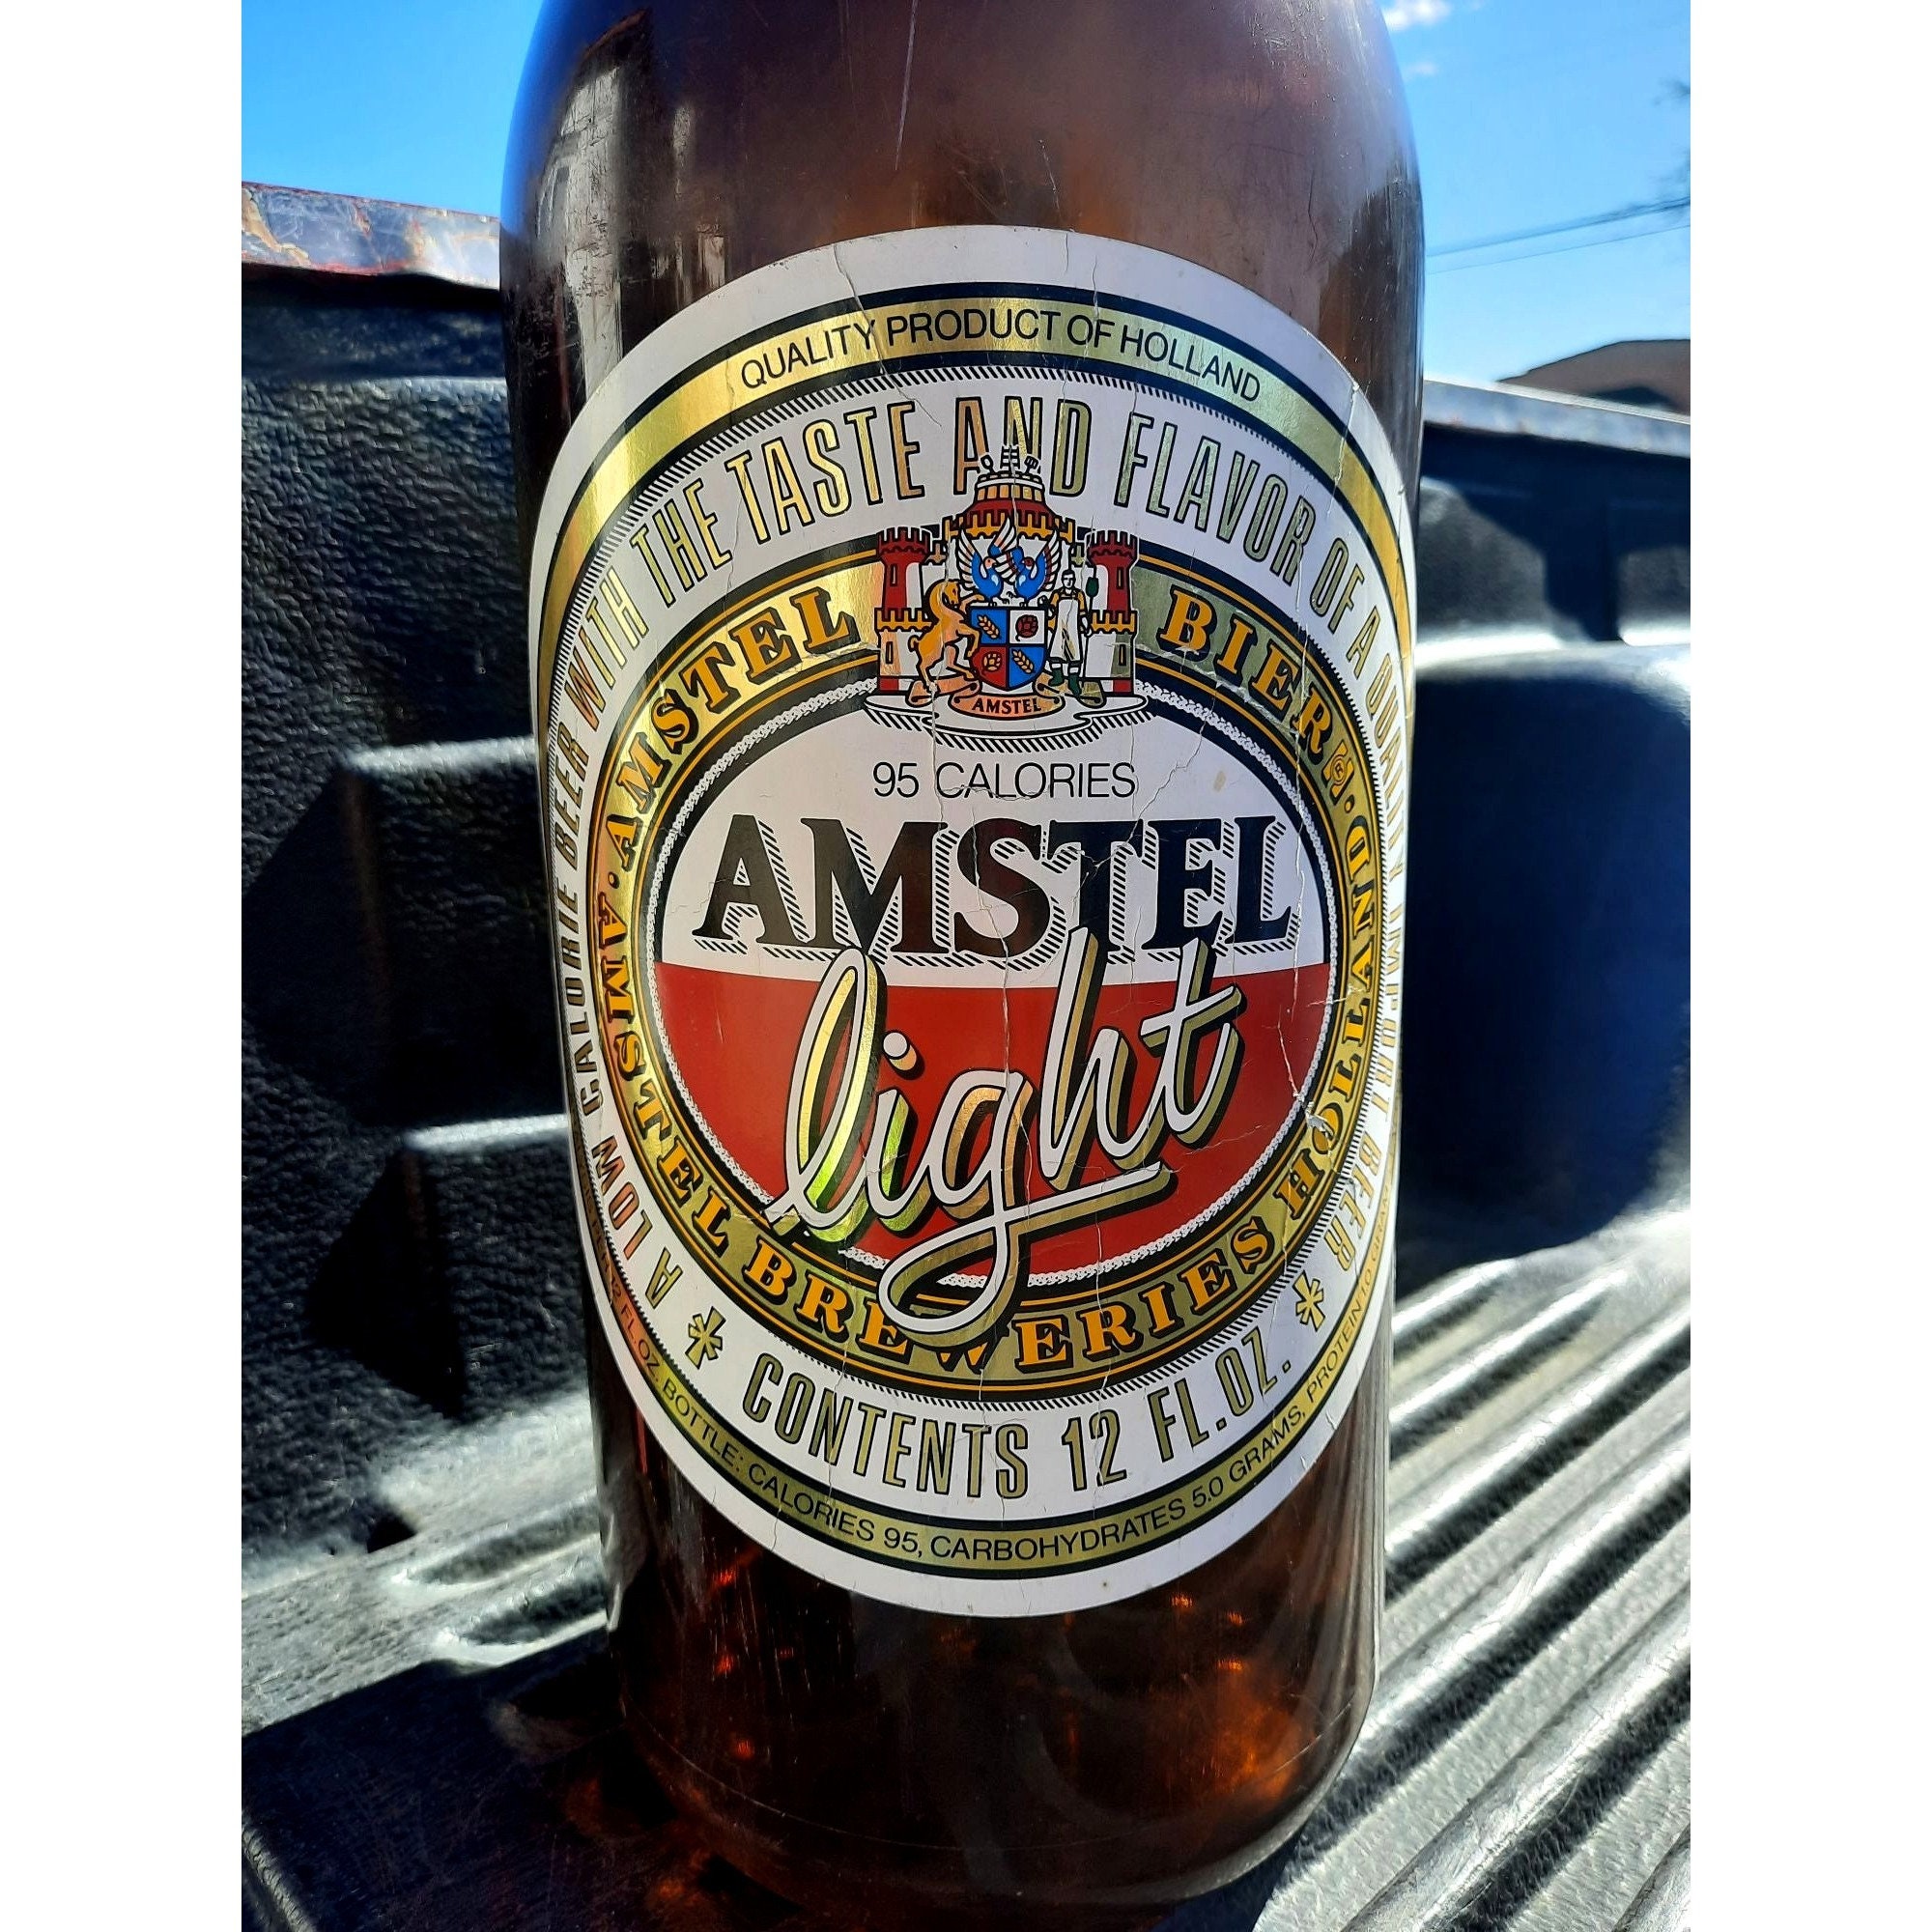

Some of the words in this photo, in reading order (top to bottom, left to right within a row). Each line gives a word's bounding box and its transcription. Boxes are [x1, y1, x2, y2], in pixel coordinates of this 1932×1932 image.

[741, 319, 876, 388] QUALITY
[887, 308, 1059, 348] PRODUCT
[1067, 314, 1116, 350] OF
[1120, 329, 1262, 404] HOLLAND
[724, 400, 925, 545] TASTE
[952, 395, 1093, 497] AND
[1113, 412, 1317, 587] FLAVOR
[630, 477, 733, 609] THE
[1309, 537, 1365, 635] OF
[564, 567, 649, 732] WITH
[971, 696, 1042, 716] AMSTEL
[1346, 605, 1381, 680] A
[554, 721, 589, 870] BEER
[605, 585, 862, 872] AMSTEL
[1155, 582, 1334, 765] BIER
[872, 761, 920, 798] 95
[935, 761, 1137, 799] CALORIES
[691, 814, 1296, 967] AMSTEL
[556, 875, 604, 1117] CALORIE
[597, 891, 730, 1250] AMSTEL
[741, 1215, 1276, 1376] BREERIES
[1271, 815, 1376, 1222] HOLLAND
[763, 925, 1246, 1345] light
[592, 1135, 653, 1261] LOW
[1323, 1130, 1382, 1272] BEER
[644, 1247, 684, 1309] A
[662, 1378, 745, 1473] BOTTLE:
[748, 1462, 875, 1543] CALORIES
[883, 1525, 923, 1558] 95,
[929, 1498, 1187, 1561] CARBOHYDRATES
[1191, 1476, 1225, 1509] 5.0
[1228, 1405, 1306, 1484] GRAMS,
[1305, 1298, 1362, 1404] PROTEIN
[741, 1351, 1029, 1500] CONTENTS
[1061, 1408, 1127, 1492] 12
